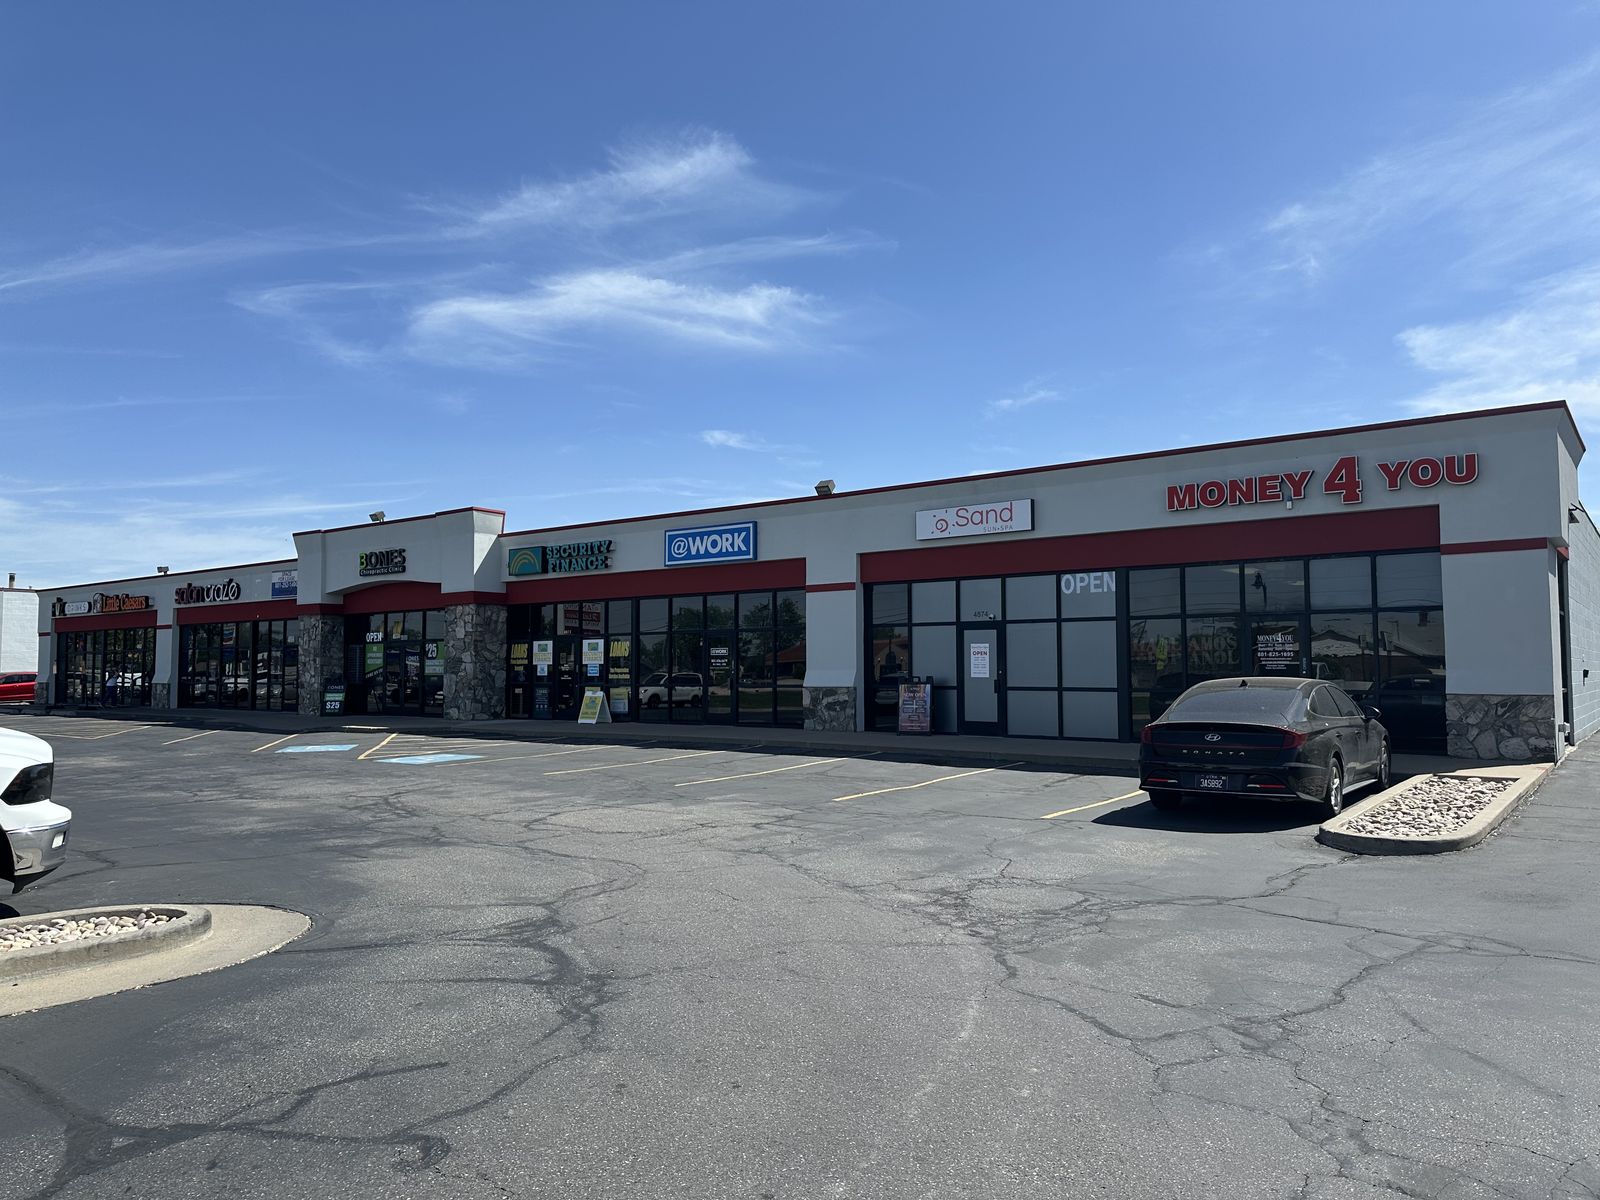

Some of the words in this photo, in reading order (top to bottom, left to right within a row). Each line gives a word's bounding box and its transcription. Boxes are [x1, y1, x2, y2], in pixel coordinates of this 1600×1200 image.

[1166, 470, 1312, 511] MONEY
[1322, 455, 1362, 504] 4
[1377, 452, 1478, 491] YOU
[955, 501, 1013, 527] Sand
[546, 540, 611, 559] SECURITY
[671, 530, 748, 558] @WORK
[359, 549, 406, 568] BONES
[548, 556, 609, 573] FINANCE
[360, 567, 388, 576] Chiropractic
[389, 565, 404, 573] Clinic
[1060, 572, 1116, 594] OPEN
[103, 595, 120, 612] Little
[120, 593, 146, 610] Caesars
[175, 583, 204, 604] salon
[365, 632, 382, 643] OPEN
[425, 643, 437, 658] $25
[609, 641, 630, 657] LOANS
